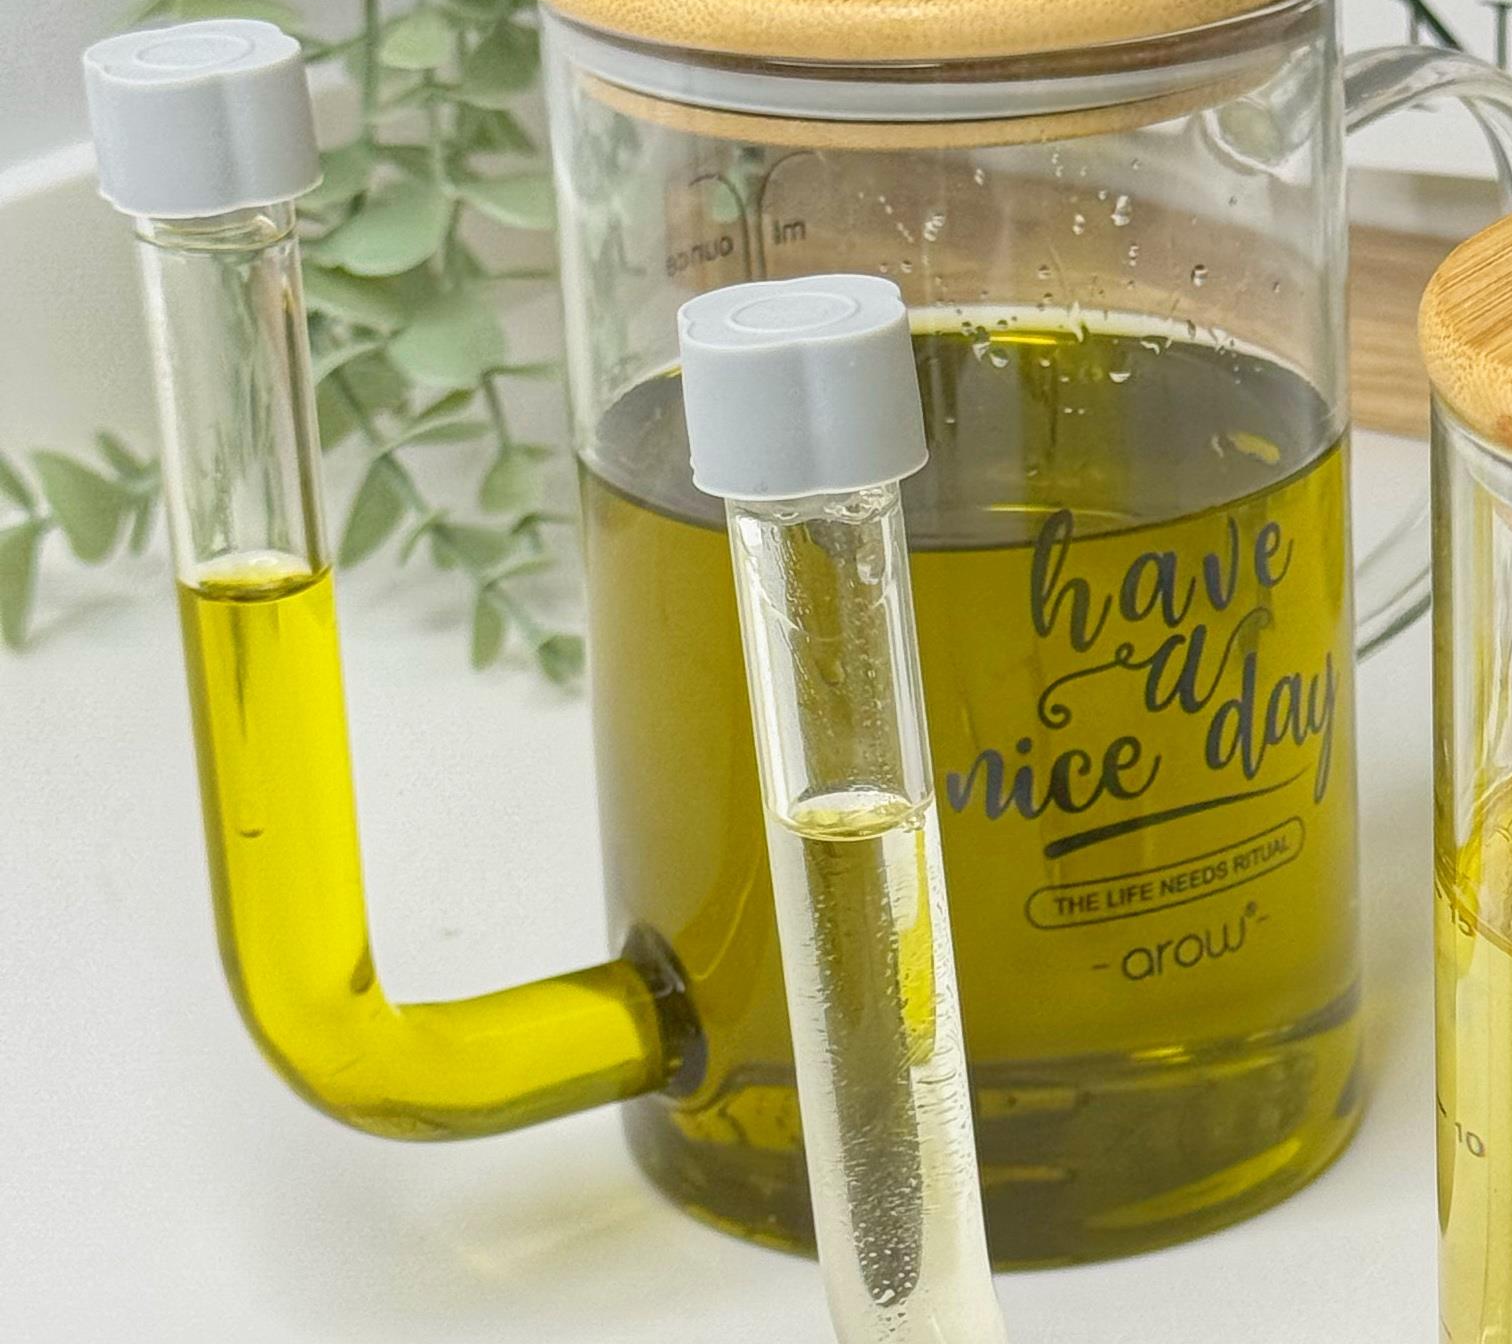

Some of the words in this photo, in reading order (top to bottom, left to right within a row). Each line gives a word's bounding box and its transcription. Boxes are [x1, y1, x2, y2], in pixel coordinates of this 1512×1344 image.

[1030, 508, 1294, 652] have
[947, 736, 1161, 820] nice
[1205, 652, 1340, 804] day
[1053, 893, 1099, 916] THE
[1106, 882, 1154, 909] LIFE
[1159, 863, 1229, 896] NEEDS
[1232, 835, 1290, 873] RITUAL
